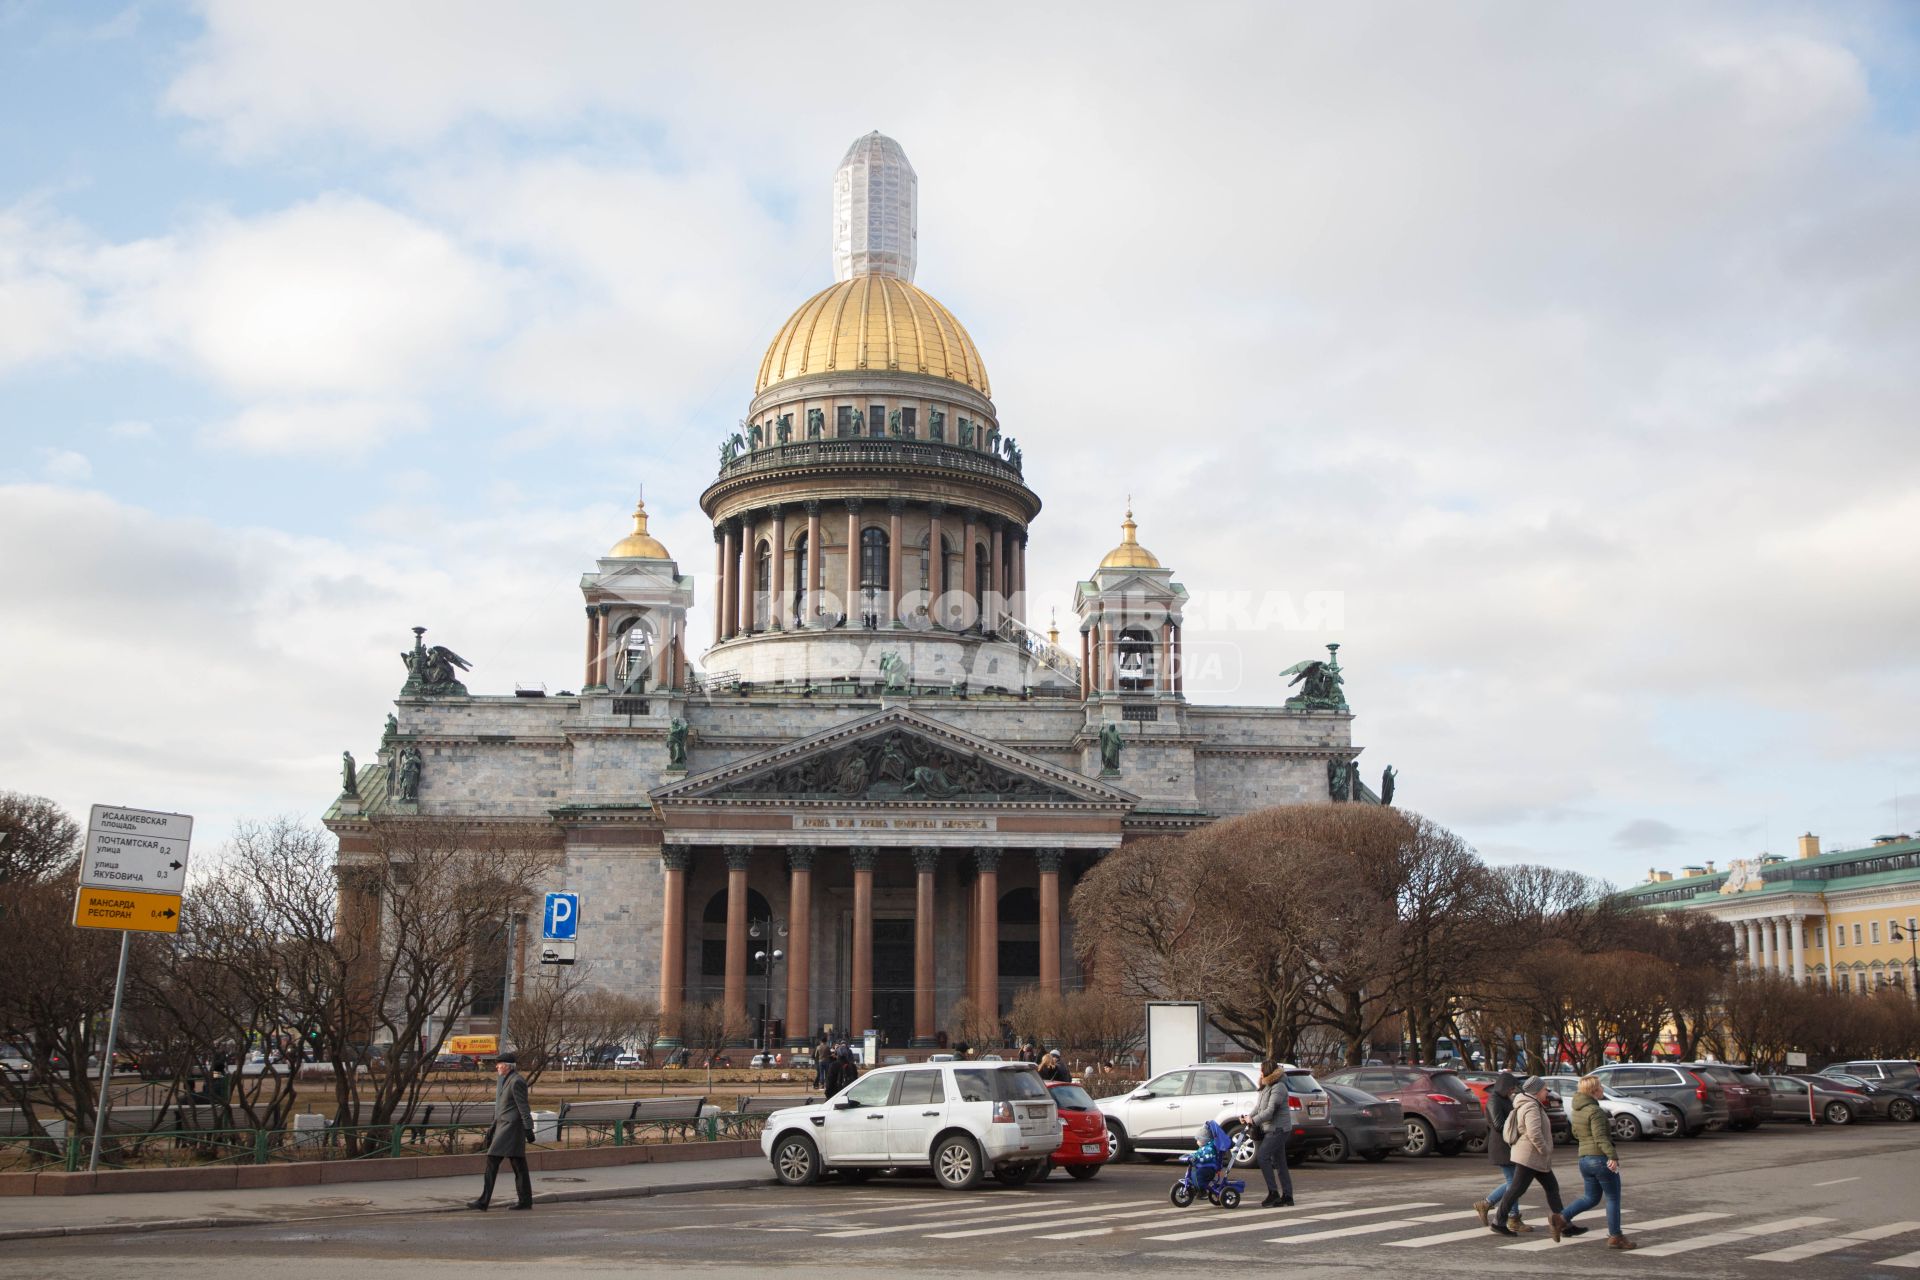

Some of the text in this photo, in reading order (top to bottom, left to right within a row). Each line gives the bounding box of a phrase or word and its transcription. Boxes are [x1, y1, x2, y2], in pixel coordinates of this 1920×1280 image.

[102, 811, 167, 826] ИСААКИЕВСКАЯ
[101, 820, 137, 831] площадь
[98, 836, 158, 849] ПОЧТАМТСКАЯ
[96, 846, 121, 854] улица
[160, 847, 171, 855] 0,2
[94, 861, 119, 869] улица
[93, 870, 144, 881] ЯКУБОВИЧА
[157, 870, 168, 879] 0,3
[89, 898, 135, 909] МАНСАРДА
[88, 909, 132, 918] РЕСТОРАН
[151, 910, 162, 918] 0,4
[551, 898, 571, 934] P
